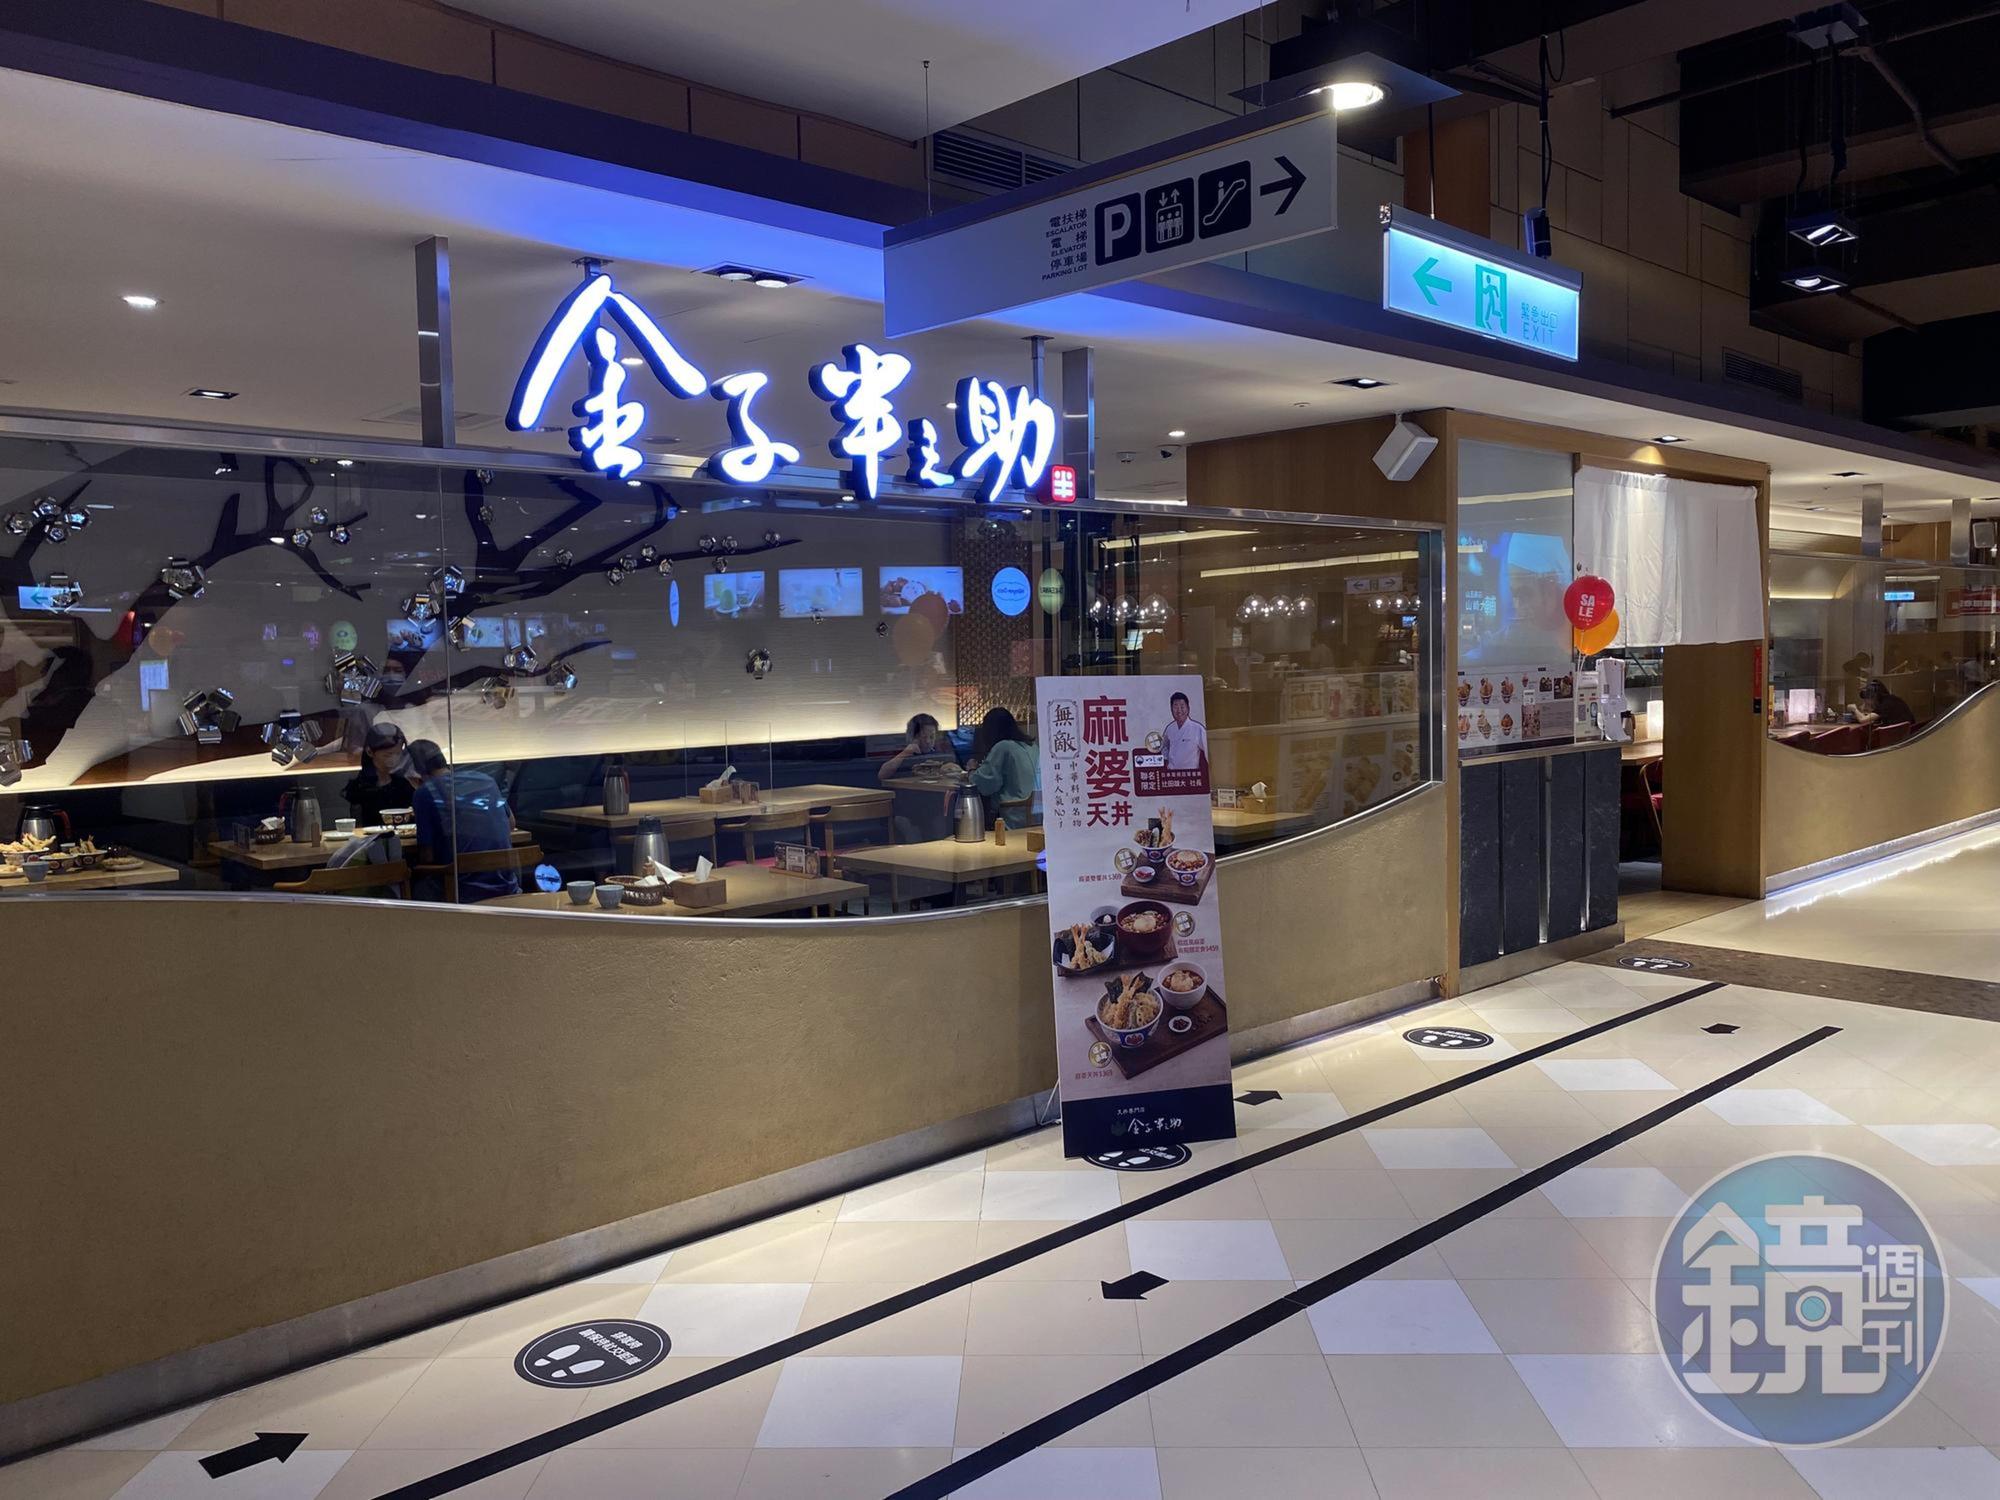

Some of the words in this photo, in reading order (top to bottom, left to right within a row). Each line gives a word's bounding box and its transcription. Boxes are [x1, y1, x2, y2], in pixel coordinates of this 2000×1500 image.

[1049, 208, 1087, 227] 電扶梯
[1046, 221, 1087, 238] ESCALATOR
[1051, 242, 1087, 257] ELEVATOR
[1051, 252, 1087, 270] 停車場
[1042, 268, 1072, 280] PARKING
[1074, 263, 1087, 273] LOT
[1523, 321, 1555, 342] EXIT
[1053, 704, 1077, 753] 無敵
[1082, 696, 1130, 799] 麻婆
[1086, 801, 1133, 827] 天丼
